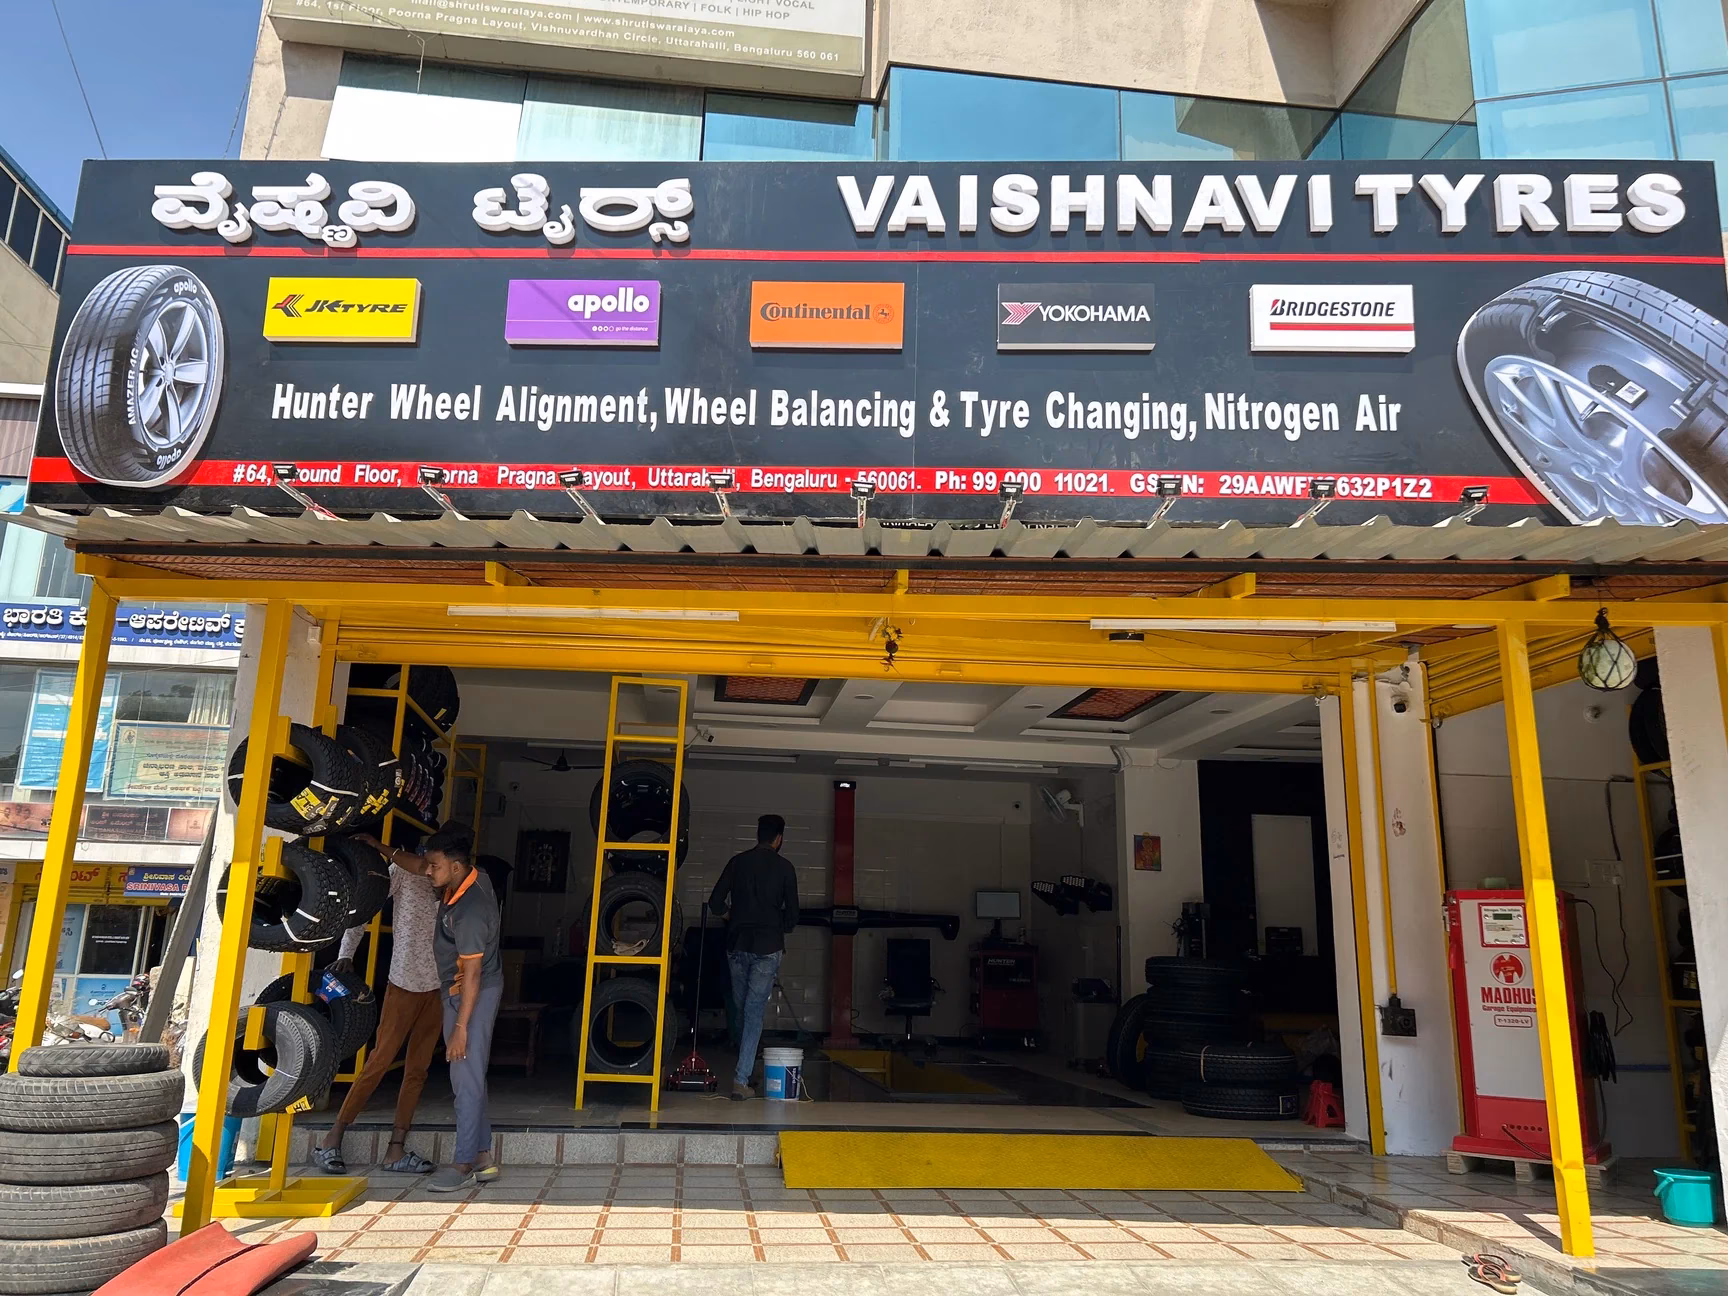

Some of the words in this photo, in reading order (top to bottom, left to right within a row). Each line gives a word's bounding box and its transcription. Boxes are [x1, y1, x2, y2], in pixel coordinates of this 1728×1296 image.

[700, 4, 731, 15] FOLK
[743, 8, 762, 17] HIP
[766, 10, 790, 20] HOP
[776, 0, 815, 10] VOCAL
[327, 1, 344, 10] 1st
[388, 7, 431, 20] Poorna
[435, 12, 478, 26] Pragna
[482, 17, 526, 31] Layout,
[531, 23, 619, 40] Vishnuvardhan
[623, 32, 661, 45] Circle,
[666, 37, 730, 52] Uttarahalli,
[733, 43, 793, 57] Bengaluru
[796, 50, 816, 60] 560
[820, 52, 839, 61] 061
[151, 172, 416, 248] ವೈಷ್ಣವಿ
[473, 172, 693, 245] ಟೈರ್ಸ್
[837, 174, 1333, 233] VAISHNAVI
[1355, 173, 1686, 233] TYRES
[173, 279, 206, 296] apollo
[567, 287, 650, 319] apollo
[759, 302, 870, 322] Continental
[1039, 305, 1151, 322] YOKOHAMA
[1270, 299, 1396, 317] BRIDGESTONE
[126, 369, 137, 425] AMAZER
[272, 383, 373, 421] Hunter
[390, 384, 482, 421] Wheel
[495, 386, 658, 433] Alignment,
[664, 387, 756, 427] Wheel
[770, 388, 916, 438] Balancing
[929, 389, 951, 429] &
[959, 390, 1030, 436] Tyre
[1046, 391, 1197, 440] Changing,
[1204, 393, 1339, 440] Nitrogen
[1355, 394, 1402, 433] Air
[156, 447, 191, 470] apollo
[233, 464, 271, 486] #64,
[354, 465, 402, 487] Floor,
[497, 466, 556, 490] Pragna
[573, 467, 636, 490] ayout,
[751, 469, 838, 492] Bengaluru
[935, 471, 967, 490] Ph:
[1054, 473, 1115, 493] 11021.
[3, 606, 63, 628] ಭಾರತಿ
[127, 882, 180, 892] SRINIVASA
